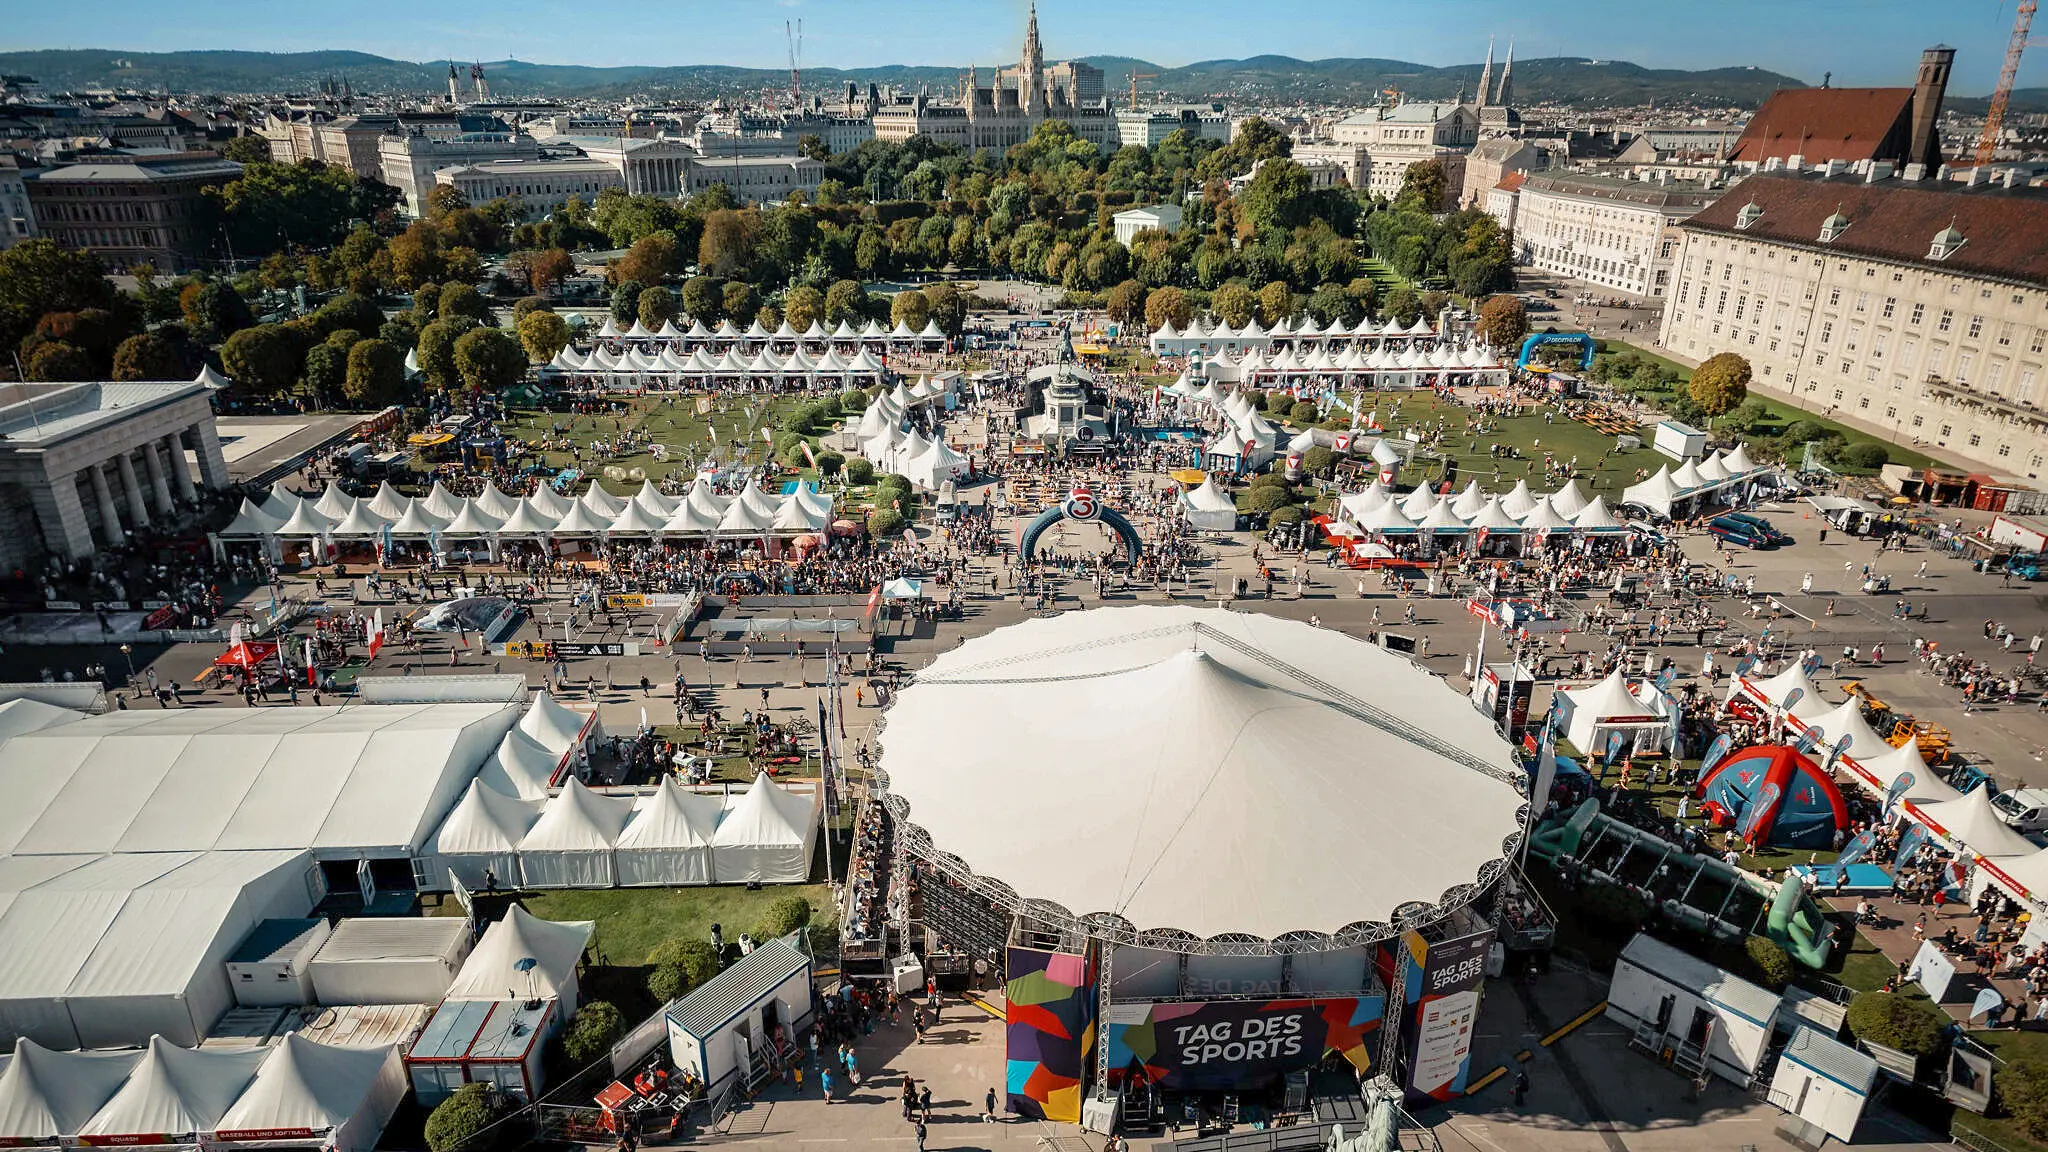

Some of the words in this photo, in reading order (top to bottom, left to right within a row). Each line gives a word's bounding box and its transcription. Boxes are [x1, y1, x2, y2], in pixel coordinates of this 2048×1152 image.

[1432, 964, 1456, 981] TAG
[1458, 954, 1483, 972] DES
[1432, 965, 1482, 990] SPORTS
[1174, 1021, 1232, 1045] TAG
[1241, 1014, 1303, 1039] DES
[1182, 1035, 1303, 1065] SPORTS
